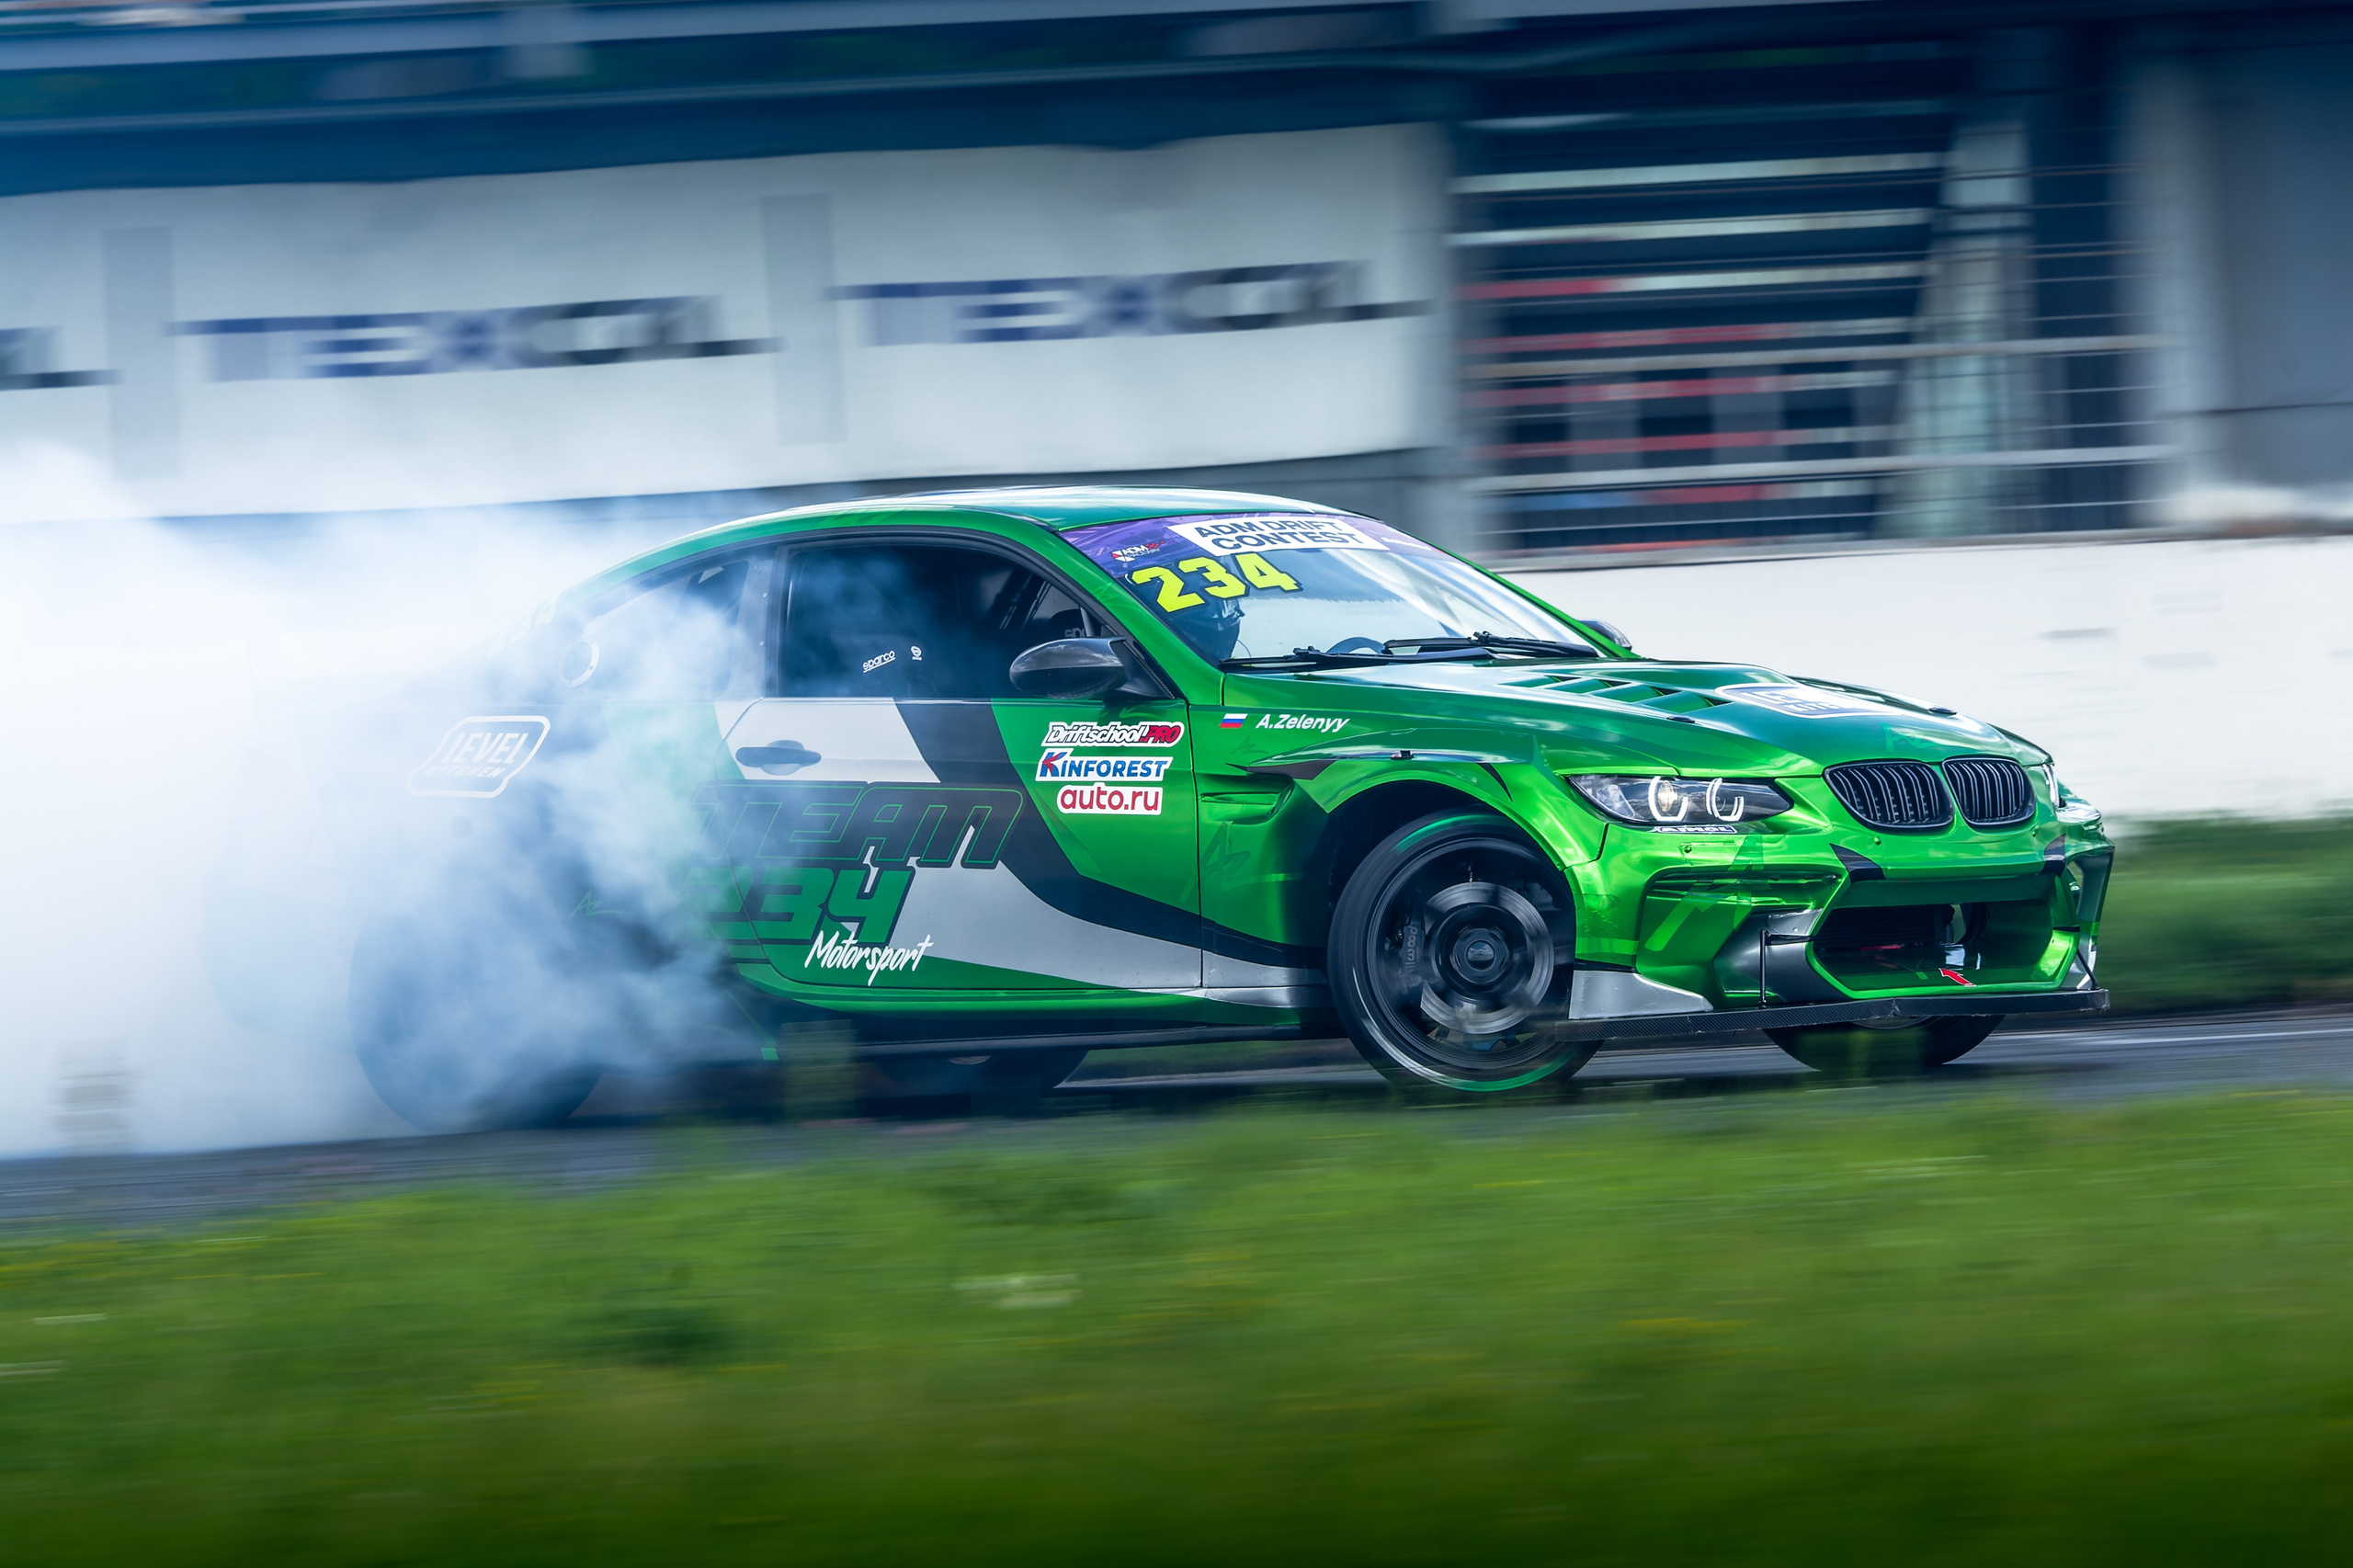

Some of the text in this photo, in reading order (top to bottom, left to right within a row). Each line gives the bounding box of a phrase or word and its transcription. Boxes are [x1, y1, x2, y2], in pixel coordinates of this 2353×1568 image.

[1195, 520, 1343, 538] ADM DRIFT
[1211, 531, 1363, 551] CONTEST
[1131, 552, 1302, 613] 234
[862, 650, 896, 674] sparco
[1255, 713, 1351, 733] A.Zelenyy
[442, 733, 529, 764] LEVEL
[422, 766, 506, 778] KITCHEN
[1040, 751, 1168, 778] KINFOREST
[1059, 786, 1160, 812] auto.ru
[690, 783, 1027, 867] TEAM
[804, 930, 934, 986] Motorsport
